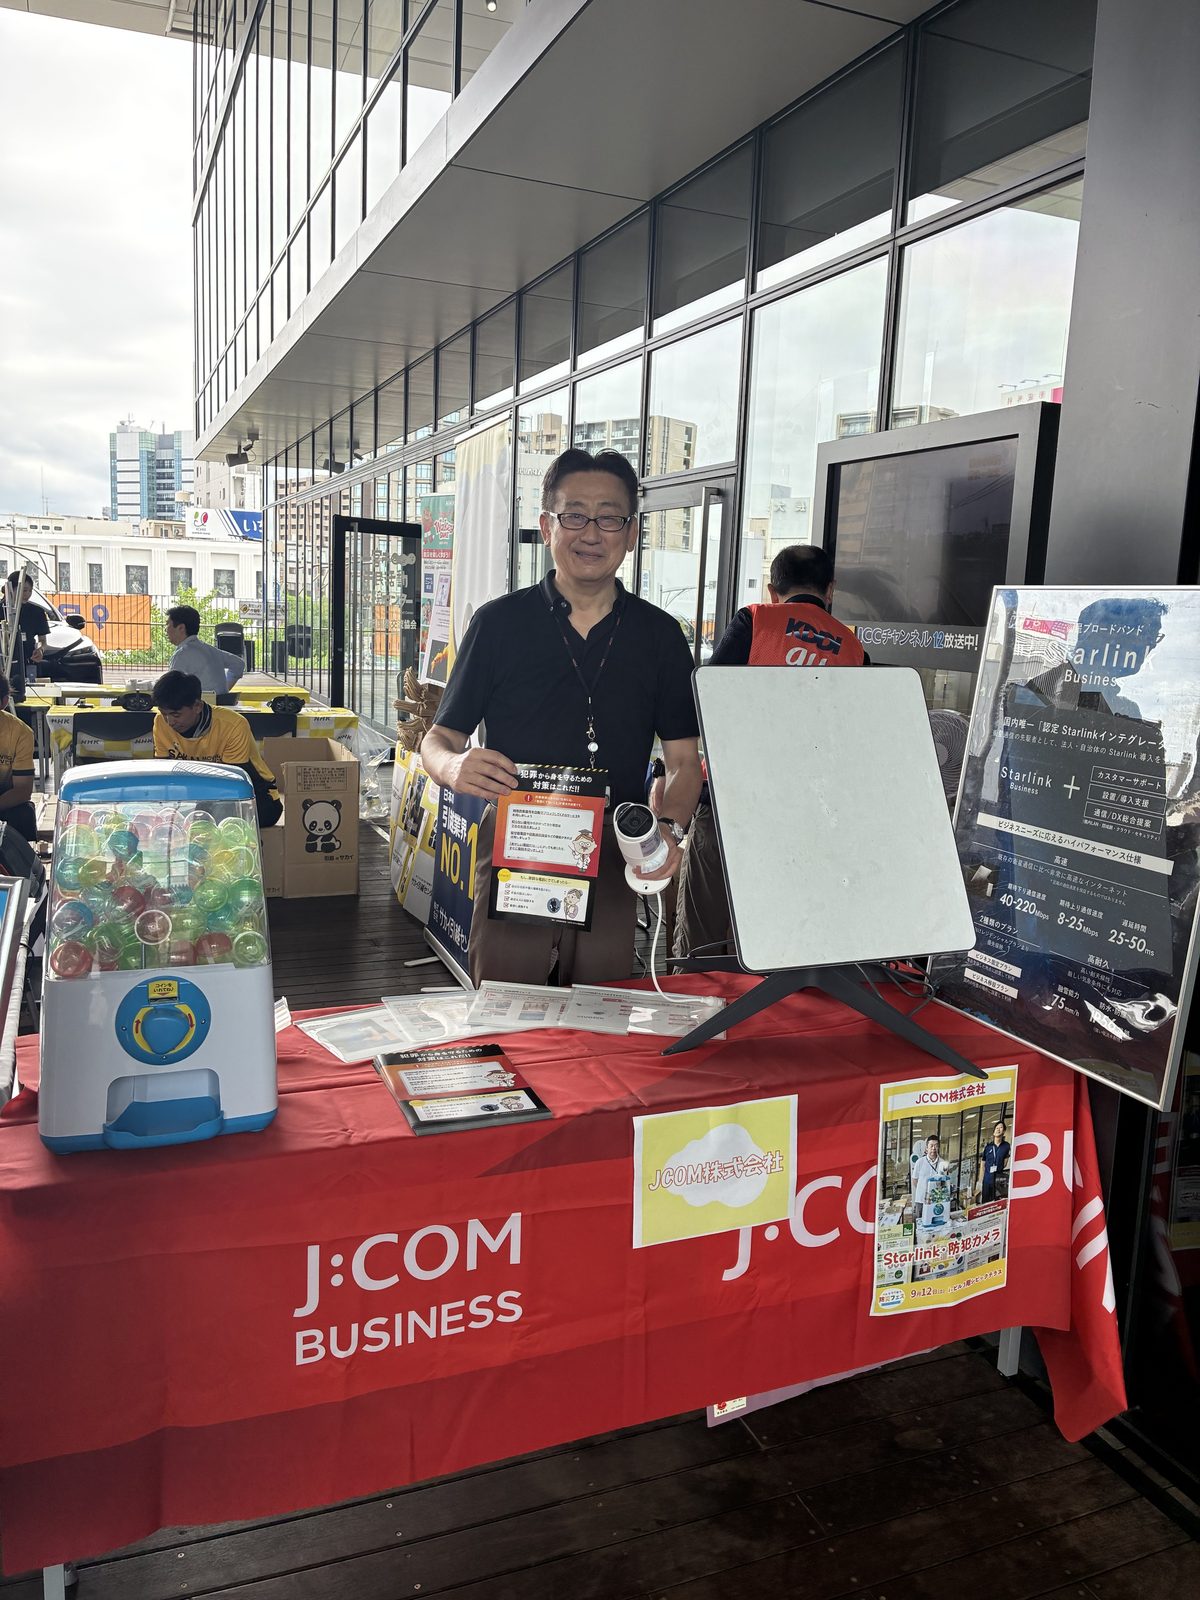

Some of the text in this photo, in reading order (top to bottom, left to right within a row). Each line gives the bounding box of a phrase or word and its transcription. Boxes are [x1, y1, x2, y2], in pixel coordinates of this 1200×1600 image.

[785, 617, 843, 656] KDDI
[1108, 747, 1137, 760] Starlink
[520, 769, 593, 783] 犯罪から身を守るための
[1001, 766, 1053, 788] Starlink
[1097, 771, 1162, 790] カスタマーサポート
[1010, 782, 1039, 795] Business
[1102, 790, 1150, 808] 設置/導入支援
[1093, 807, 1152, 829] 通信/DX総合提案
[998, 820, 1142, 866] ビジネスニーズに応えるハイパフォーマンス仕様
[1054, 855, 1068, 867] 高速
[1007, 882, 1047, 901] 期待下り通信速度
[1059, 899, 1104, 920] 期待上り通信速度
[1121, 919, 1147, 933] 遅延時間
[1087, 954, 1110, 970] 高耐久
[915, 1082, 986, 1104] JCOM株式会社
[648, 1150, 784, 1191] JCOM株式会社
[292, 1212, 522, 1318] J:COM
[295, 1290, 523, 1366] BUSINESS
